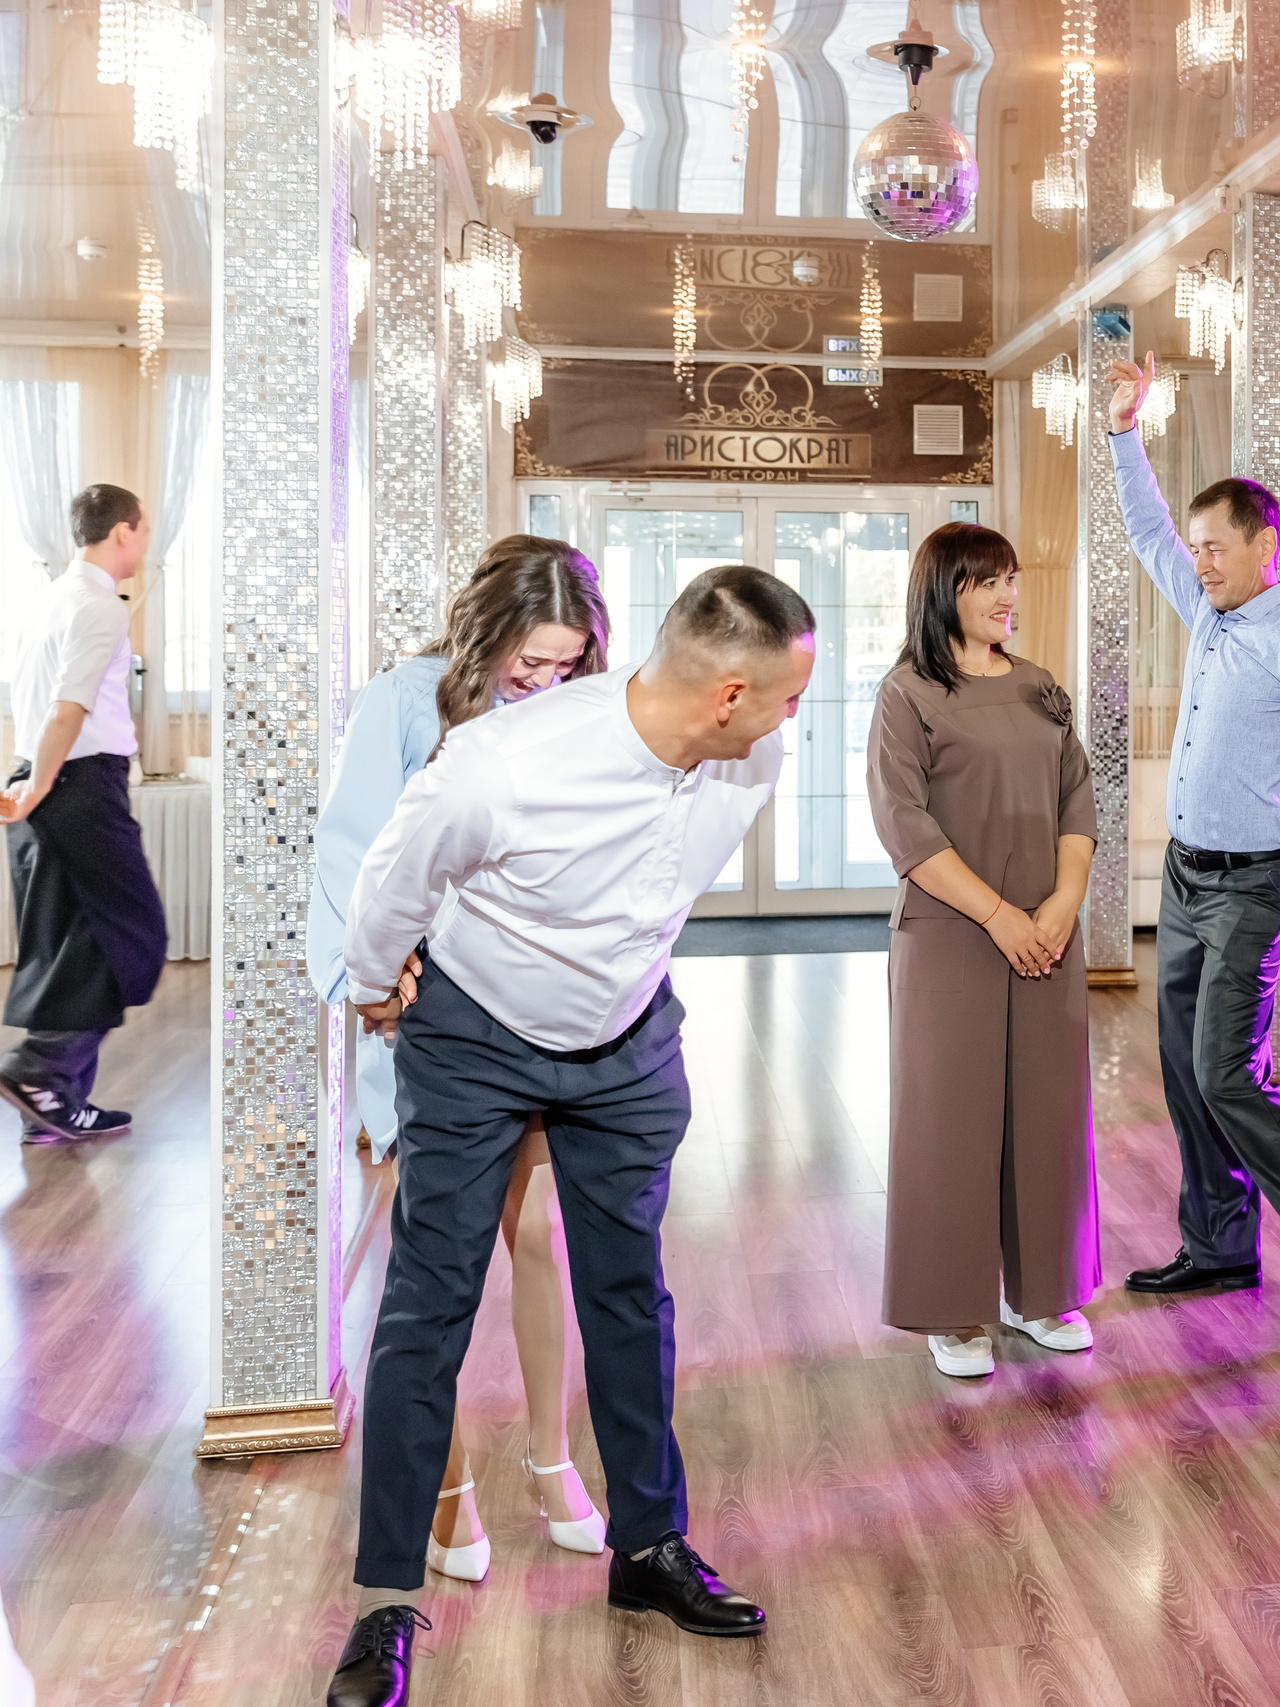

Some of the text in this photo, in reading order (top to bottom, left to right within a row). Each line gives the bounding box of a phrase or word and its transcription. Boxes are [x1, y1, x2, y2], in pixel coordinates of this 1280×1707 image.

[828, 368, 878, 382] ВЫХОД
[665, 434, 852, 464] АРИСТОКРАТ
[711, 469, 799, 481] РЕСТОРАН
